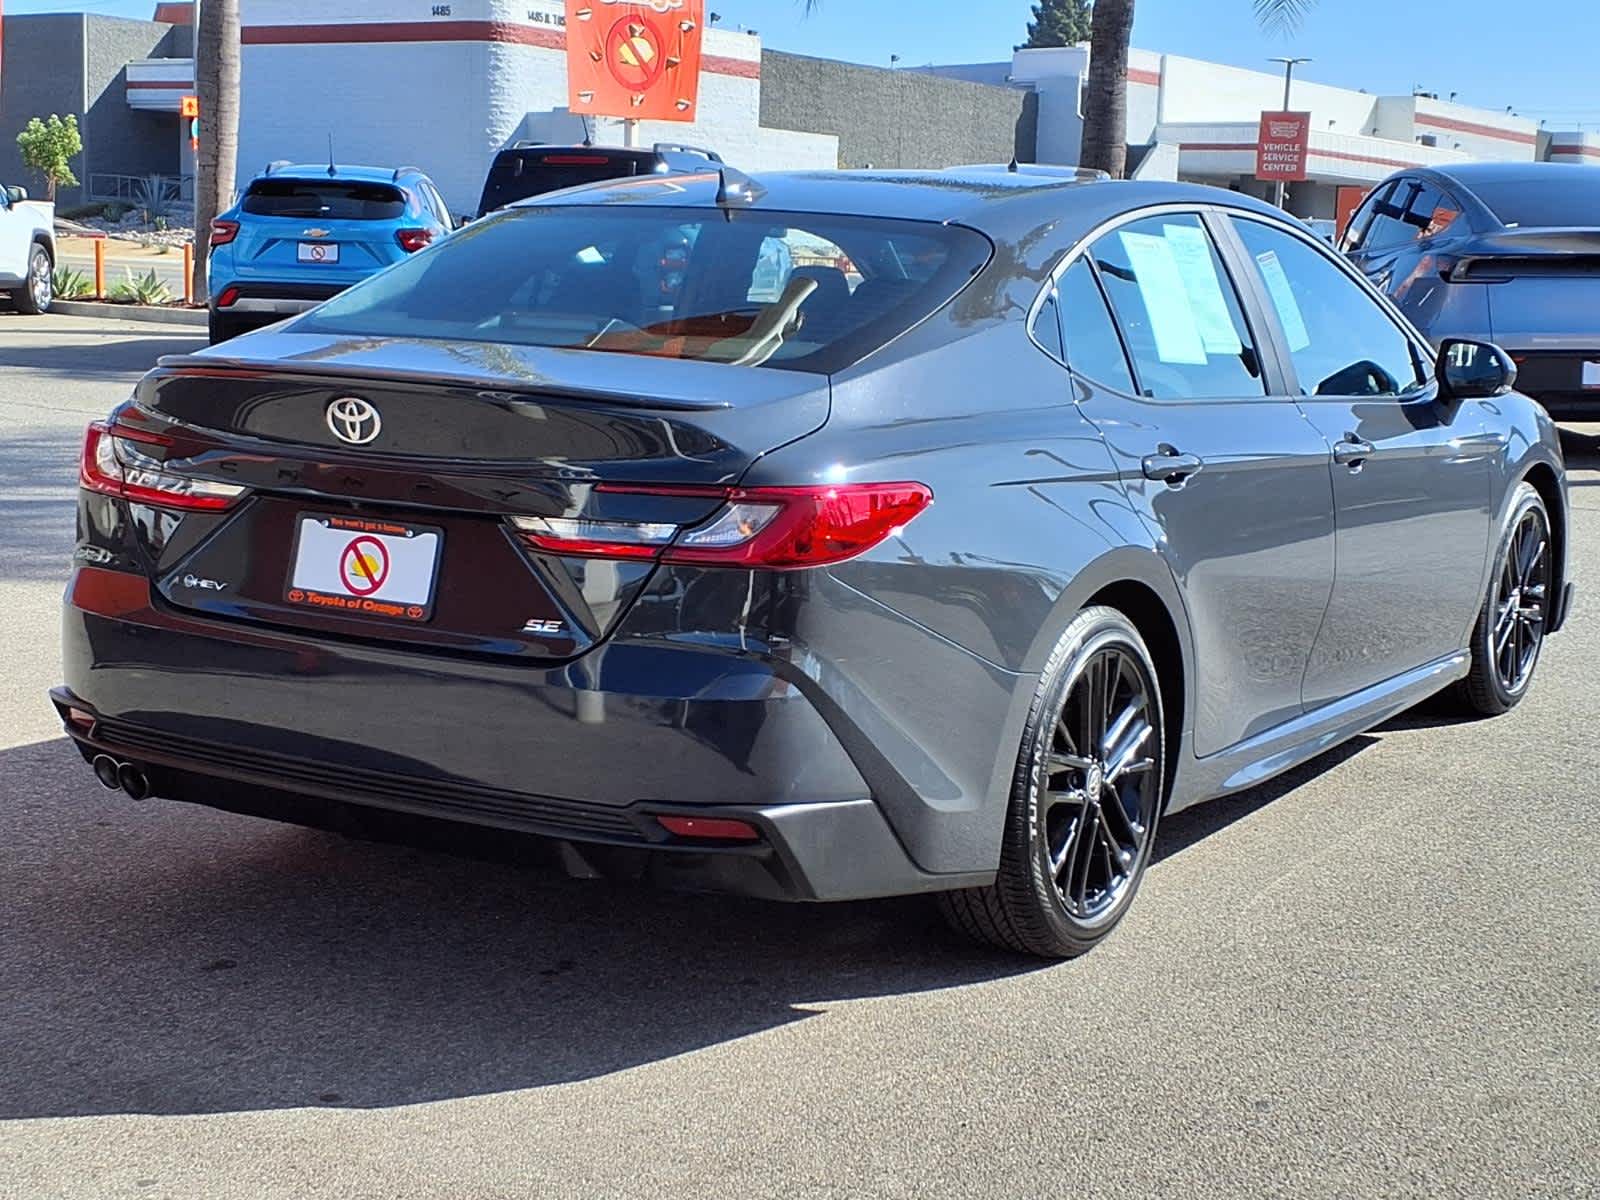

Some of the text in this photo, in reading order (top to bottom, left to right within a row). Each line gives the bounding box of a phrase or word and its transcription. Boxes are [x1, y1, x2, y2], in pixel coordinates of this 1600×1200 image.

[432, 5, 451, 16] 1485
[528, 11, 543, 22] 1485
[1263, 143, 1301, 152] VEHICLE
[1263, 152, 1299, 162] SERVICE
[1263, 163, 1297, 172] CENTER
[306, 591, 405, 616] Toyota of Orange
[522, 618, 564, 633] SE
